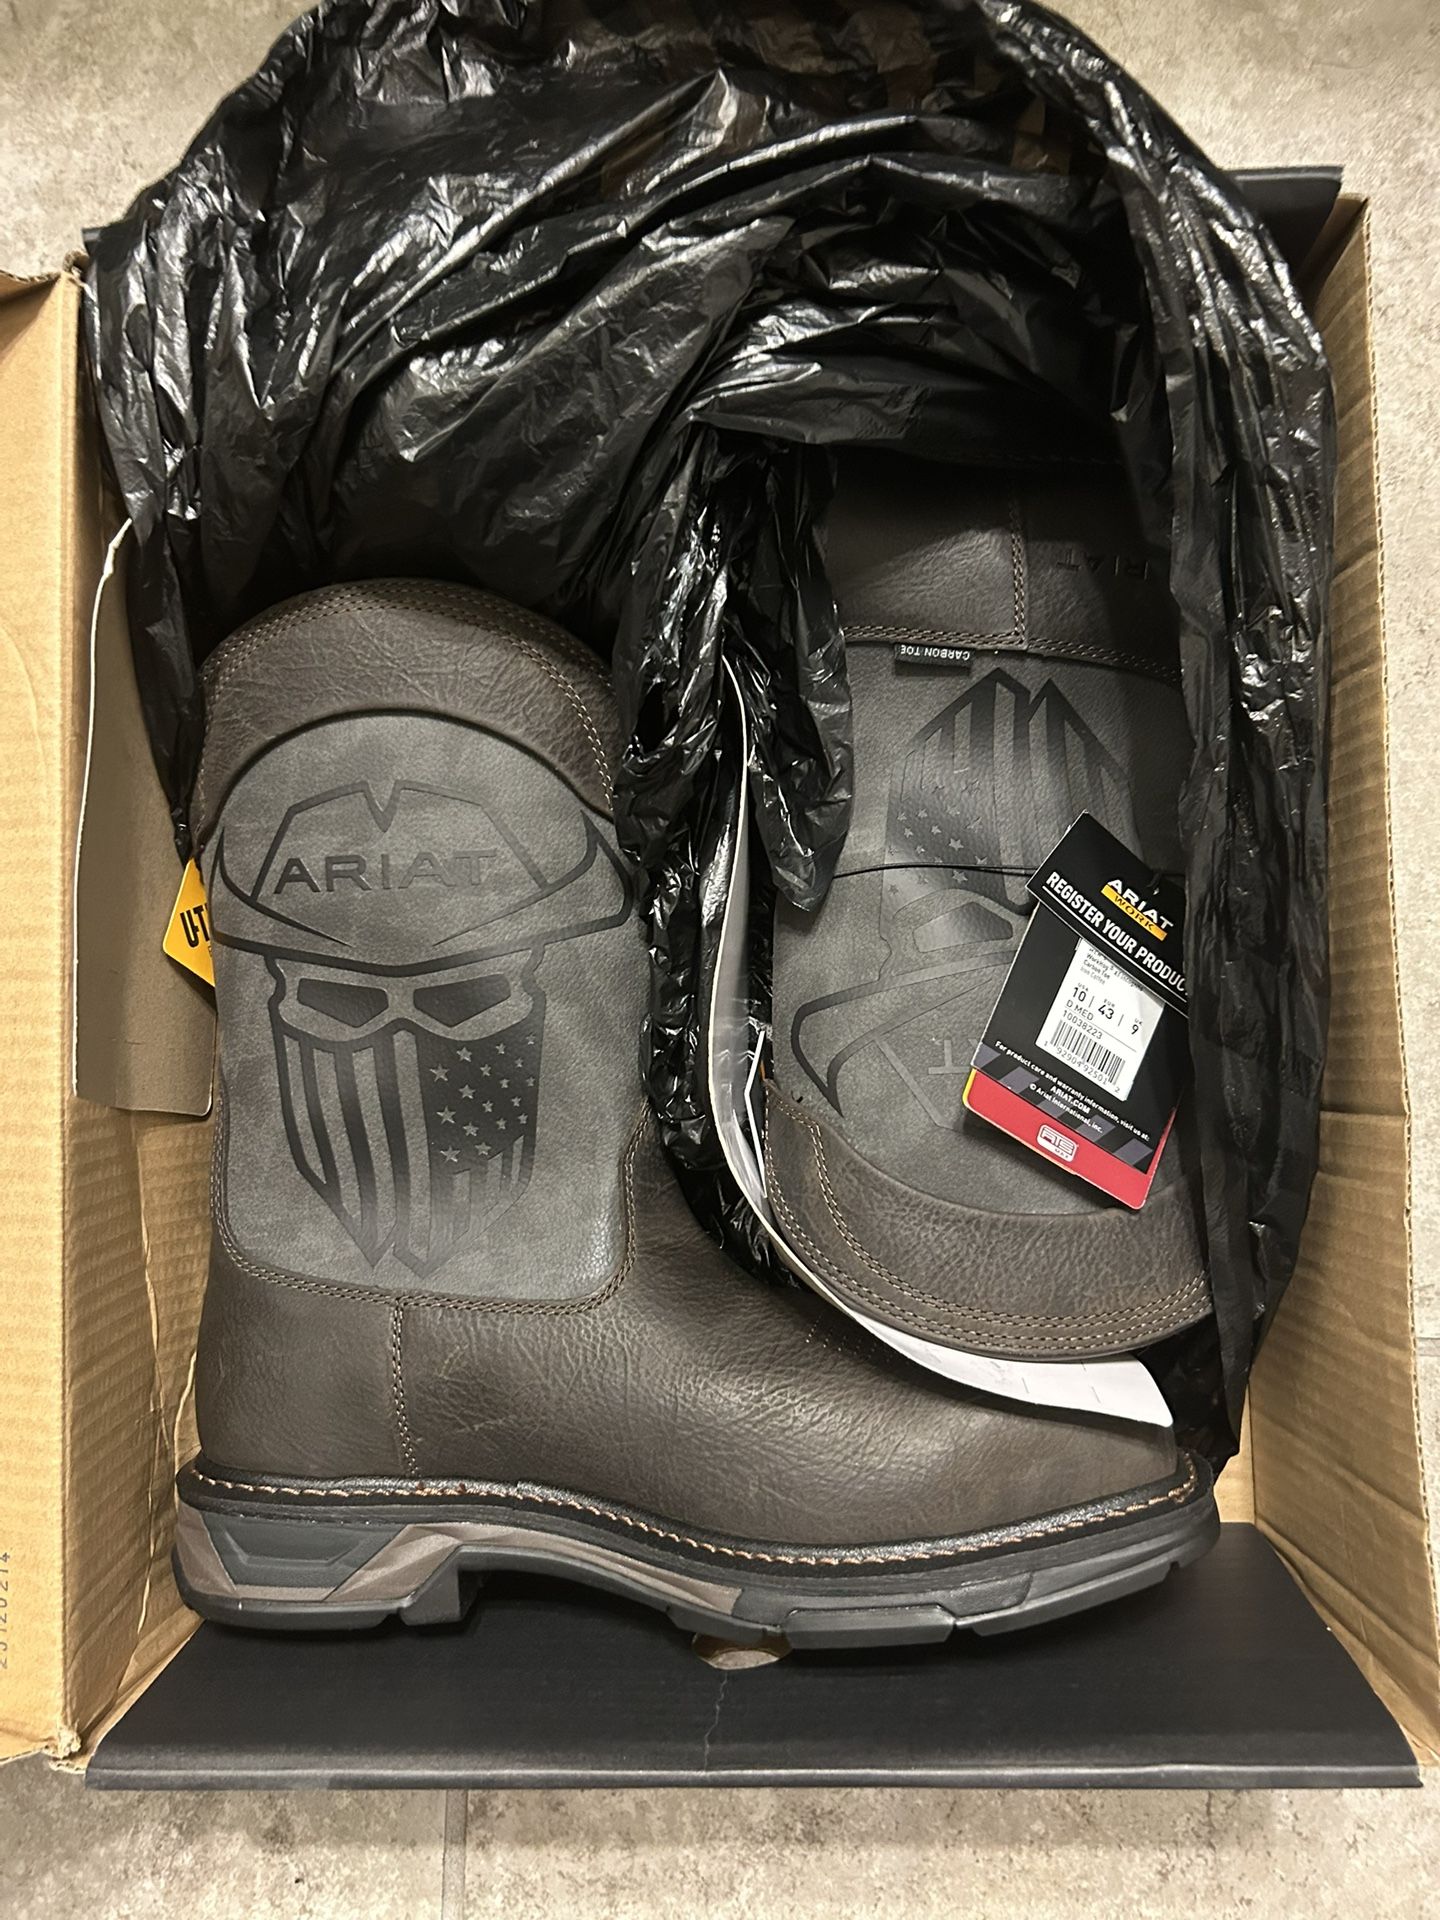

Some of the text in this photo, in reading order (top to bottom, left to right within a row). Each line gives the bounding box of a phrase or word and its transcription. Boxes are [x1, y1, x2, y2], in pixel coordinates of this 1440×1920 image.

[900, 644, 970, 661] CARBON TOE
[273, 849, 497, 895] ARIAT
[1107, 879, 1174, 930] ARIAT
[1114, 895, 1155, 932] WORK
[180, 902, 210, 948] U-T
[1046, 871, 1188, 995] REGISTER YOUR PRODUC
[1083, 959, 1101, 974] Carbon
[1077, 982, 1089, 992] USA
[1062, 1009, 1103, 1040] 10038223
[1066, 999, 1094, 1021] D MED
[1072, 986, 1139, 1035] 10 43 9
[995, 1040, 1008, 1051] For
[1006, 1049, 1031, 1067] product
[1031, 1064, 1045, 1075] care
[1045, 1072, 1058, 1083] and
[1056, 1080, 1085, 1101] warranty
[1084, 1095, 1120, 1123] information,
[1120, 1119, 1134, 1131] visit
[1133, 1128, 1141, 1136] us
[1056, 1046, 1082, 1068] 92904
[1083, 1063, 1108, 1085] 92501
[1115, 1086, 1121, 1094] 2
[1036, 1087, 1052, 1101] Ariat
[1050, 1085, 1091, 1114] ARIAT.COM
